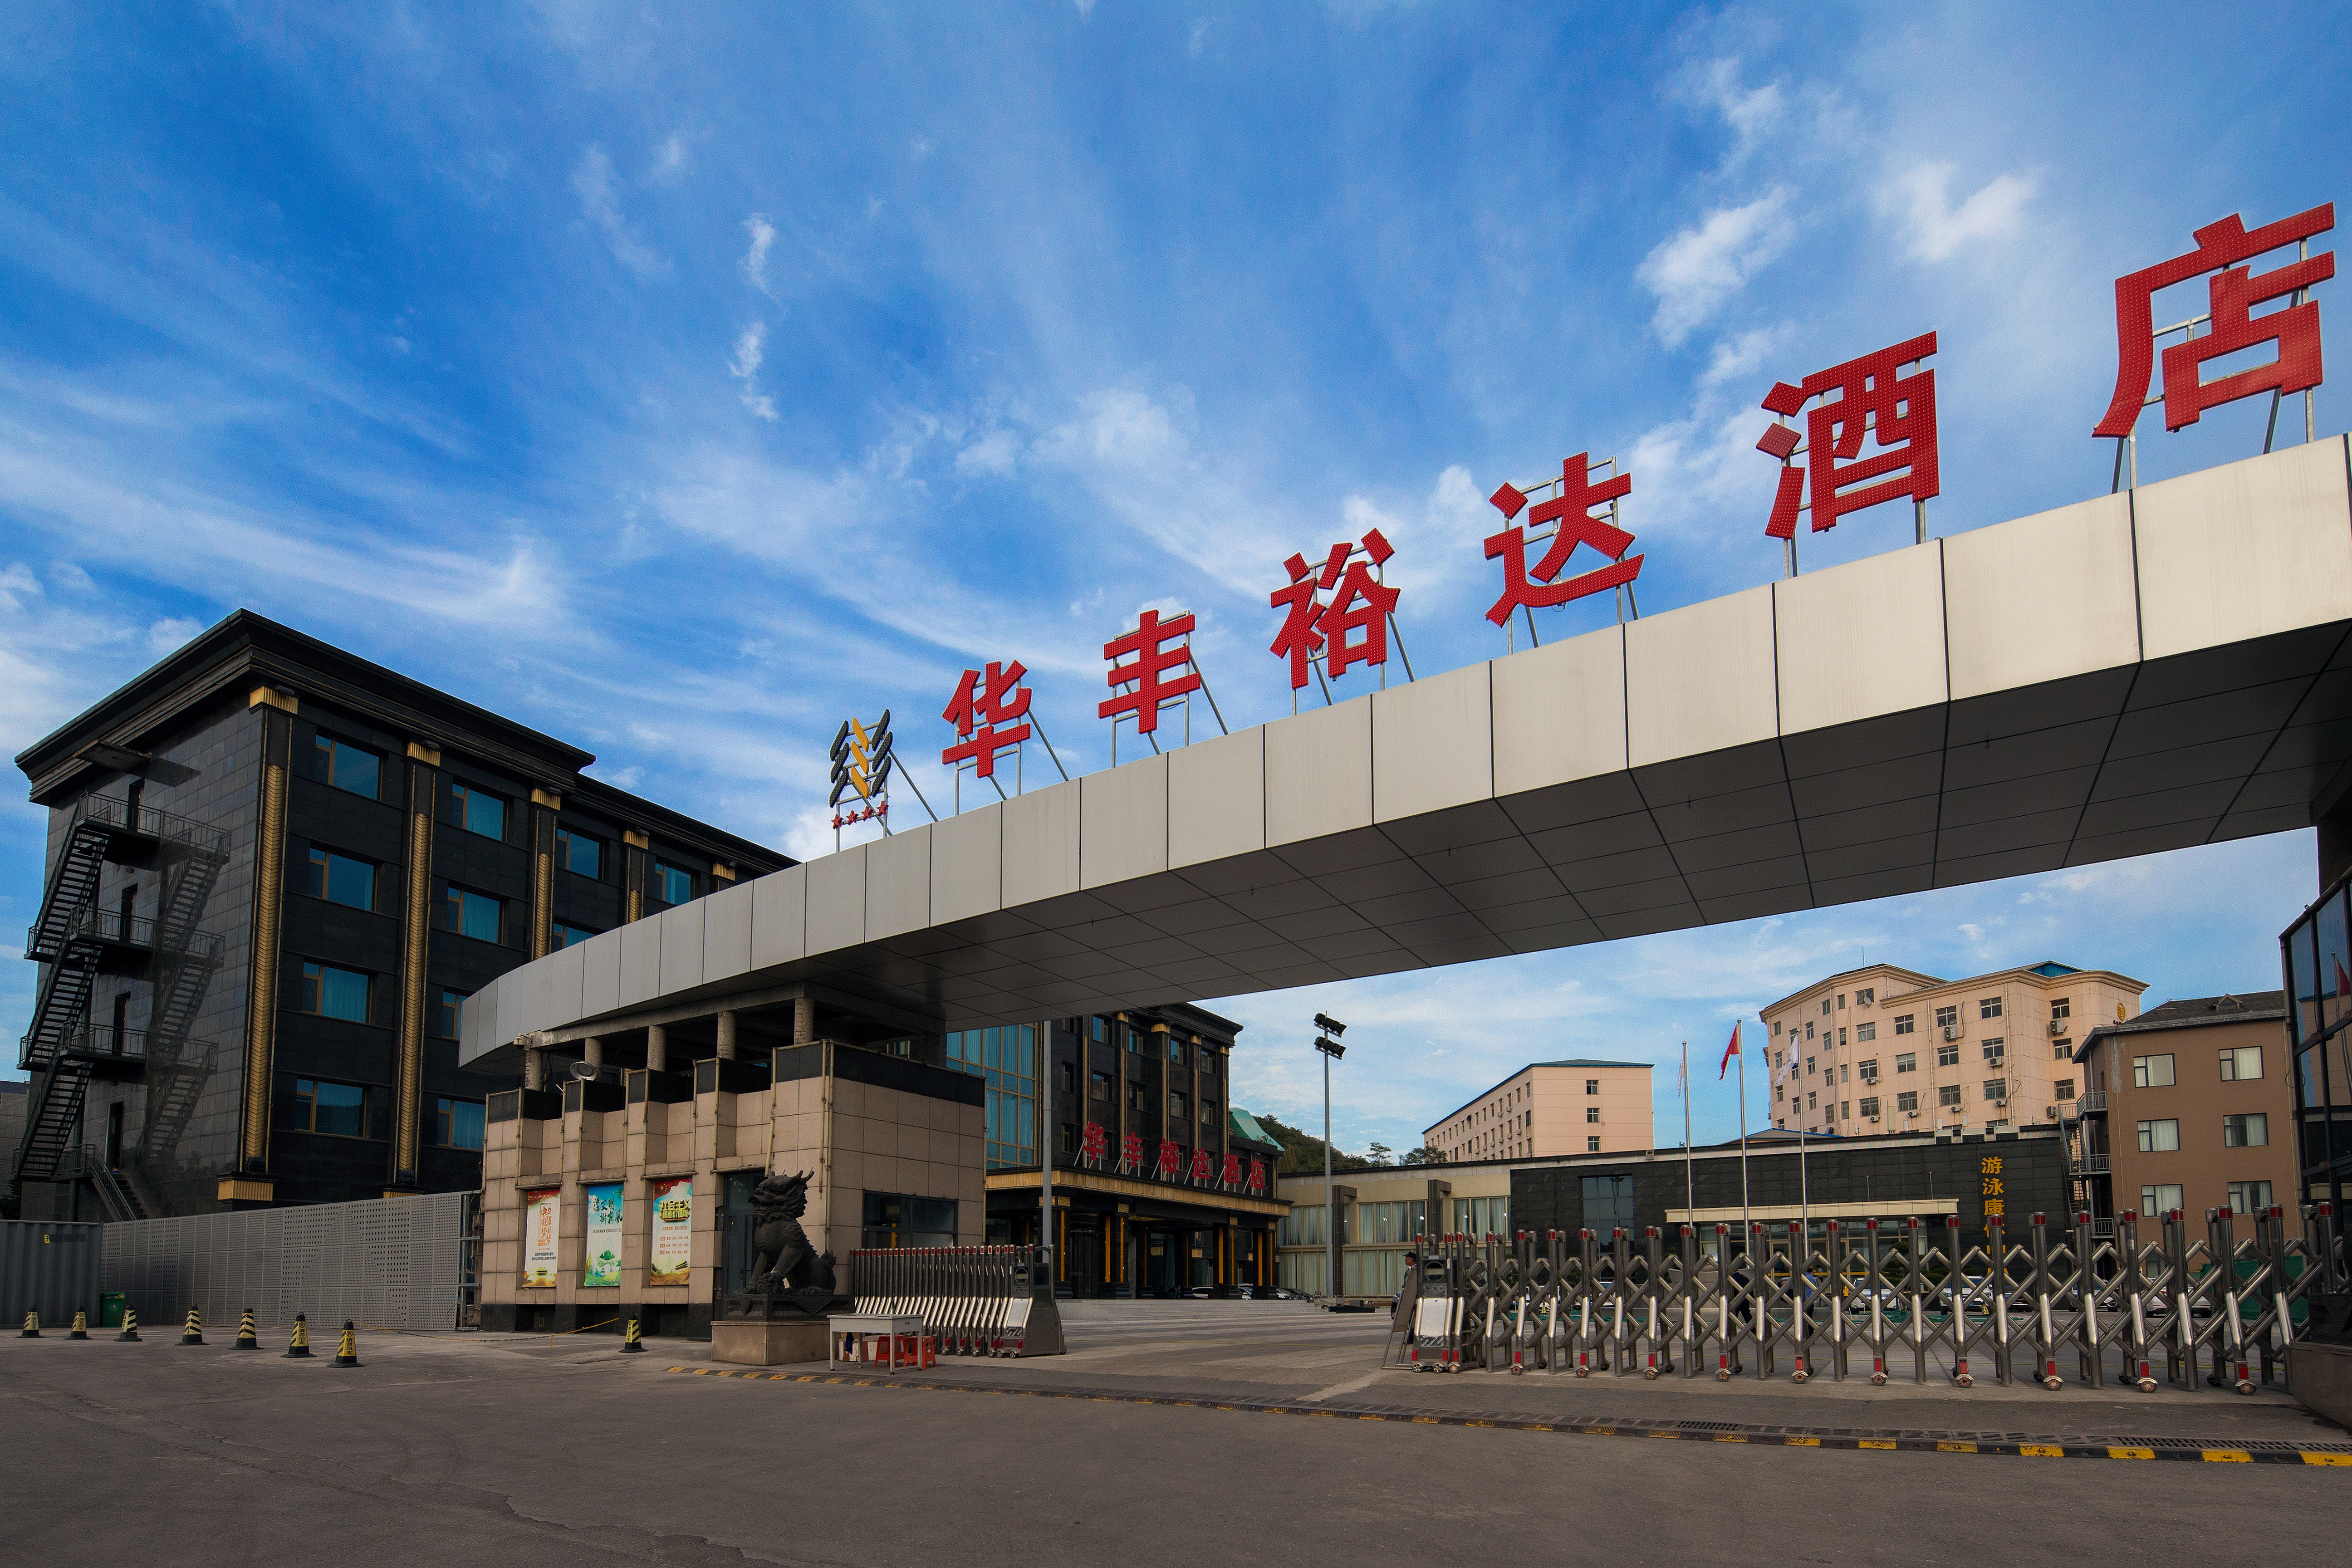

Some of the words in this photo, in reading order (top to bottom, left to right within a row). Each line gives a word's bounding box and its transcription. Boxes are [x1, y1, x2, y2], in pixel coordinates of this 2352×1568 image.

[942, 201, 2334, 778] 华丰裕达酒店
[1083, 1121, 1265, 1190] 华丰裕达酒店
[660, 1199, 691, 1211] 社会主义
